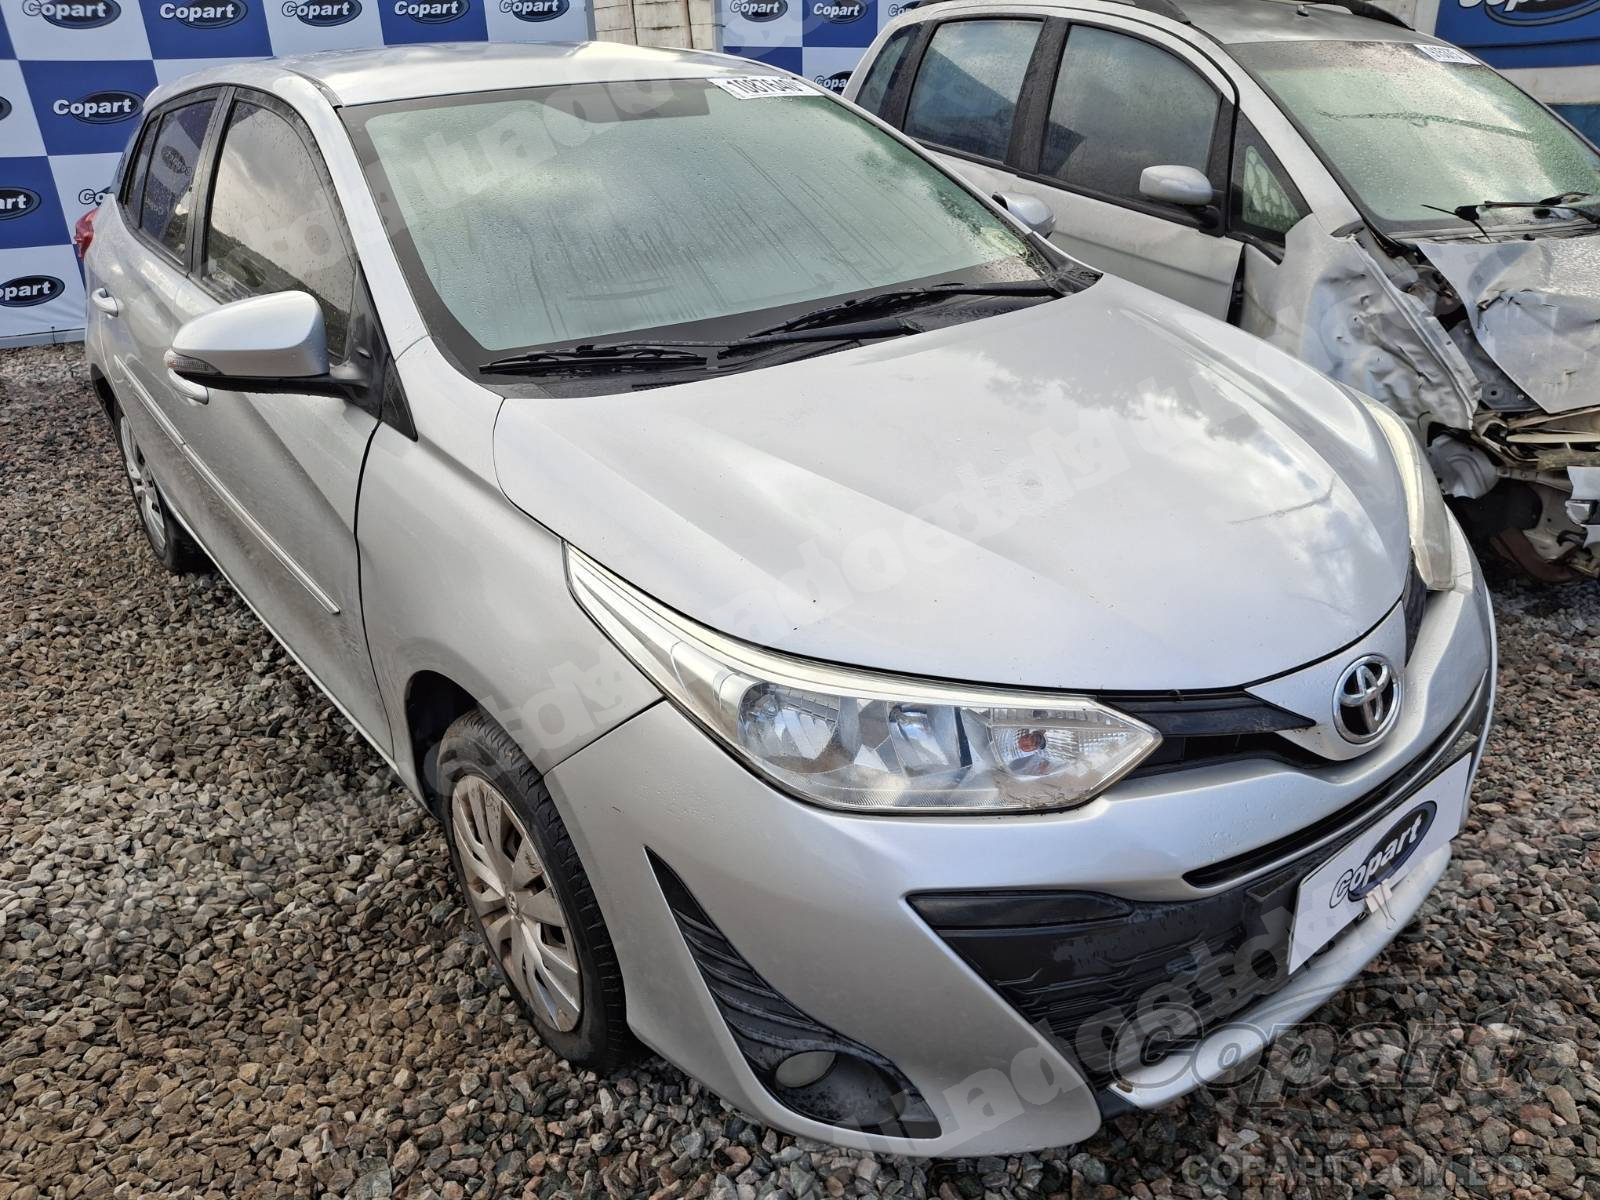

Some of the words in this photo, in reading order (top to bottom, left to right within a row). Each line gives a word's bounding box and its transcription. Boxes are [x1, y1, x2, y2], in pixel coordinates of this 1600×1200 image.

[22, 0, 107, 20] Copart
[160, 3, 235, 21] Copart
[282, 1, 350, 19] Copart
[394, 1, 459, 17] Copart
[500, 0, 559, 16] Copart
[730, 1, 780, 16] Copart
[813, 3, 860, 18] Copart
[53, 99, 131, 118] Copart
[1329, 813, 1423, 909] Copart
